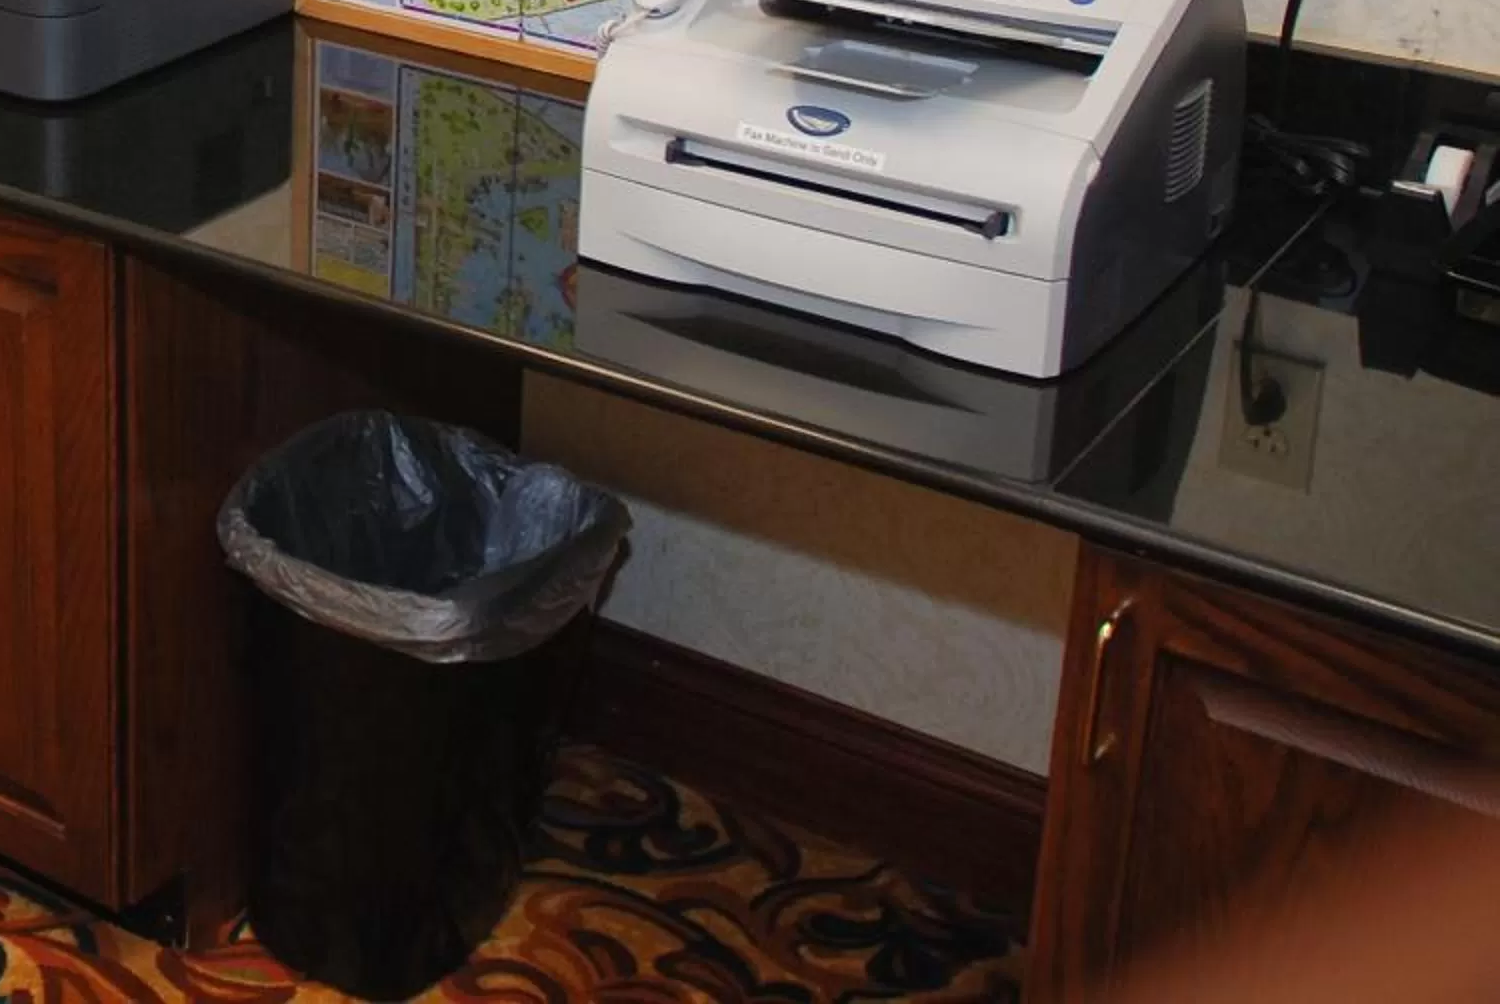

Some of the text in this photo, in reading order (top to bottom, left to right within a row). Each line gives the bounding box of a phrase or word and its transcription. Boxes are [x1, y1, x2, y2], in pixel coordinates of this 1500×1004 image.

[743, 127, 763, 140] Fax
[765, 131, 807, 151] Machine
[823, 145, 850, 160] Send
[852, 150, 878, 167] Only
